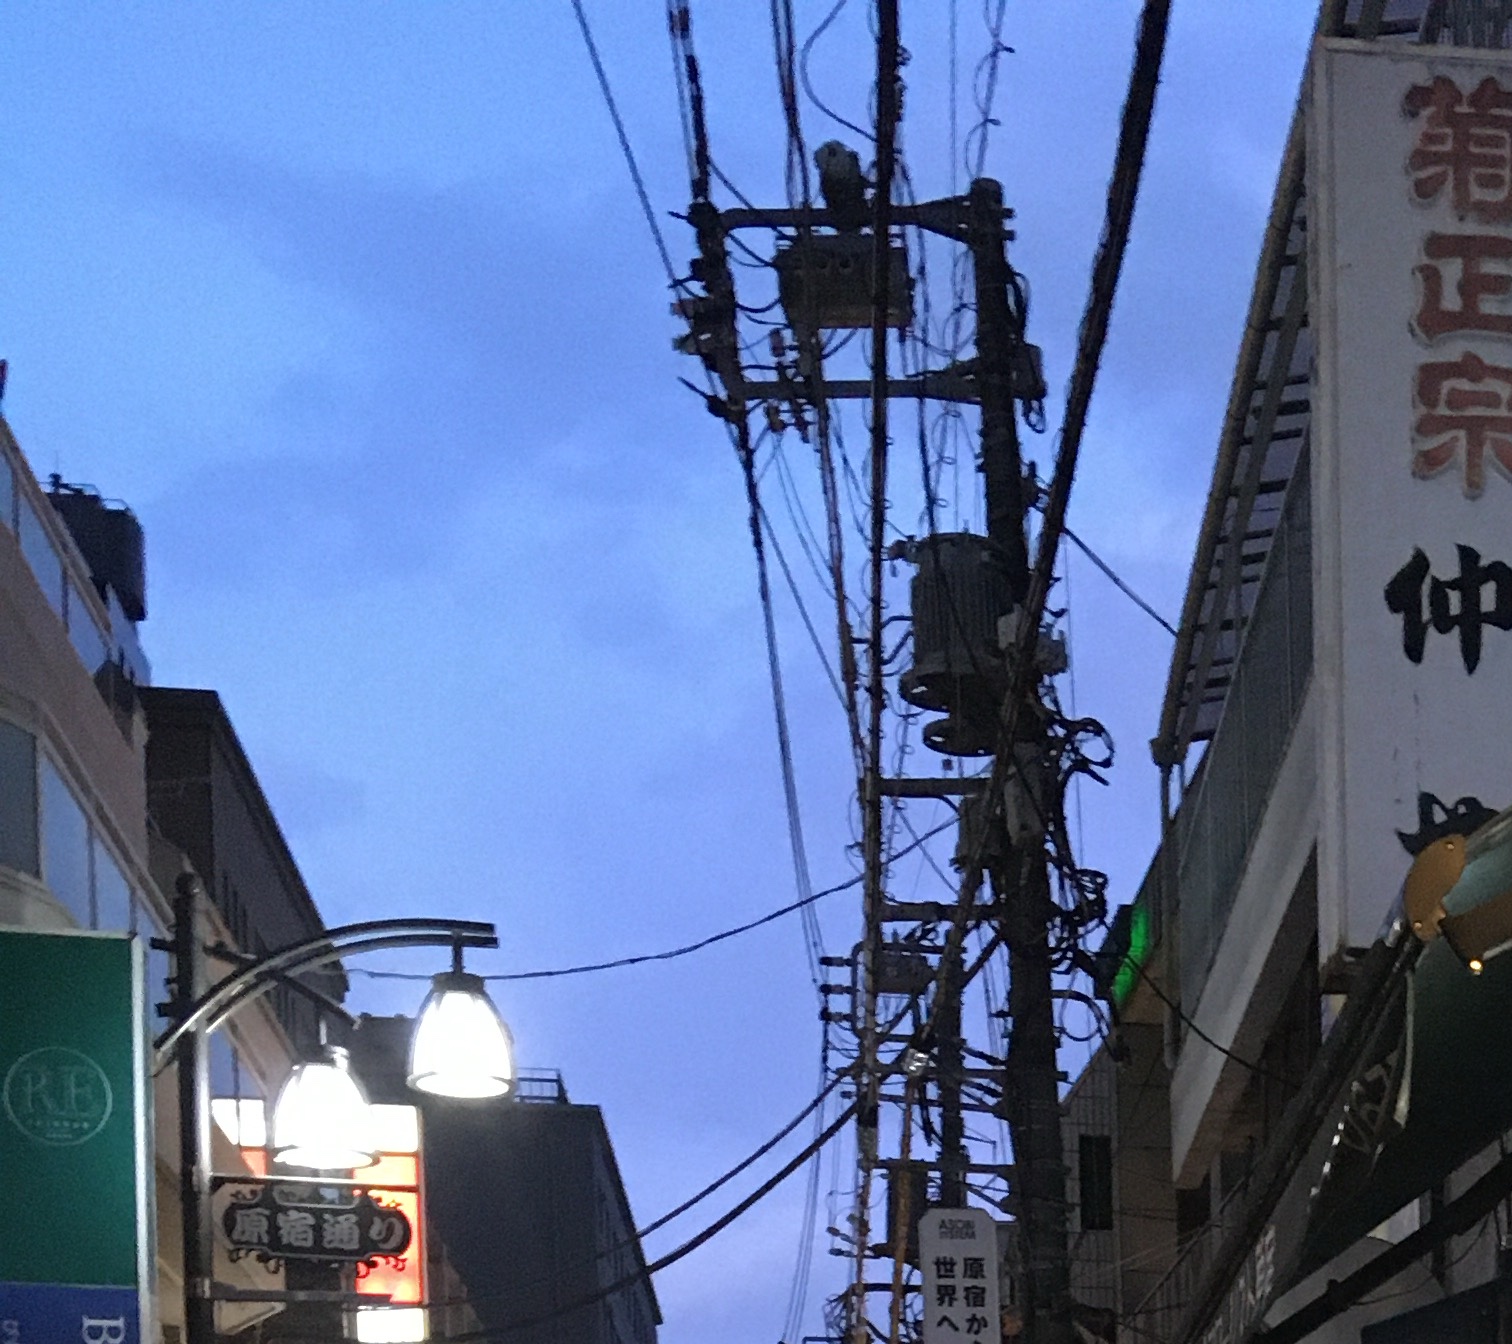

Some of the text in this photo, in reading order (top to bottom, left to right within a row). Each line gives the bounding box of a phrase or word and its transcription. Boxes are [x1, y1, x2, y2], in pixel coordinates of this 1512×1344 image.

[231, 1207, 404, 1250] 原宿通り
[933, 1255, 960, 1333] 世界へ
